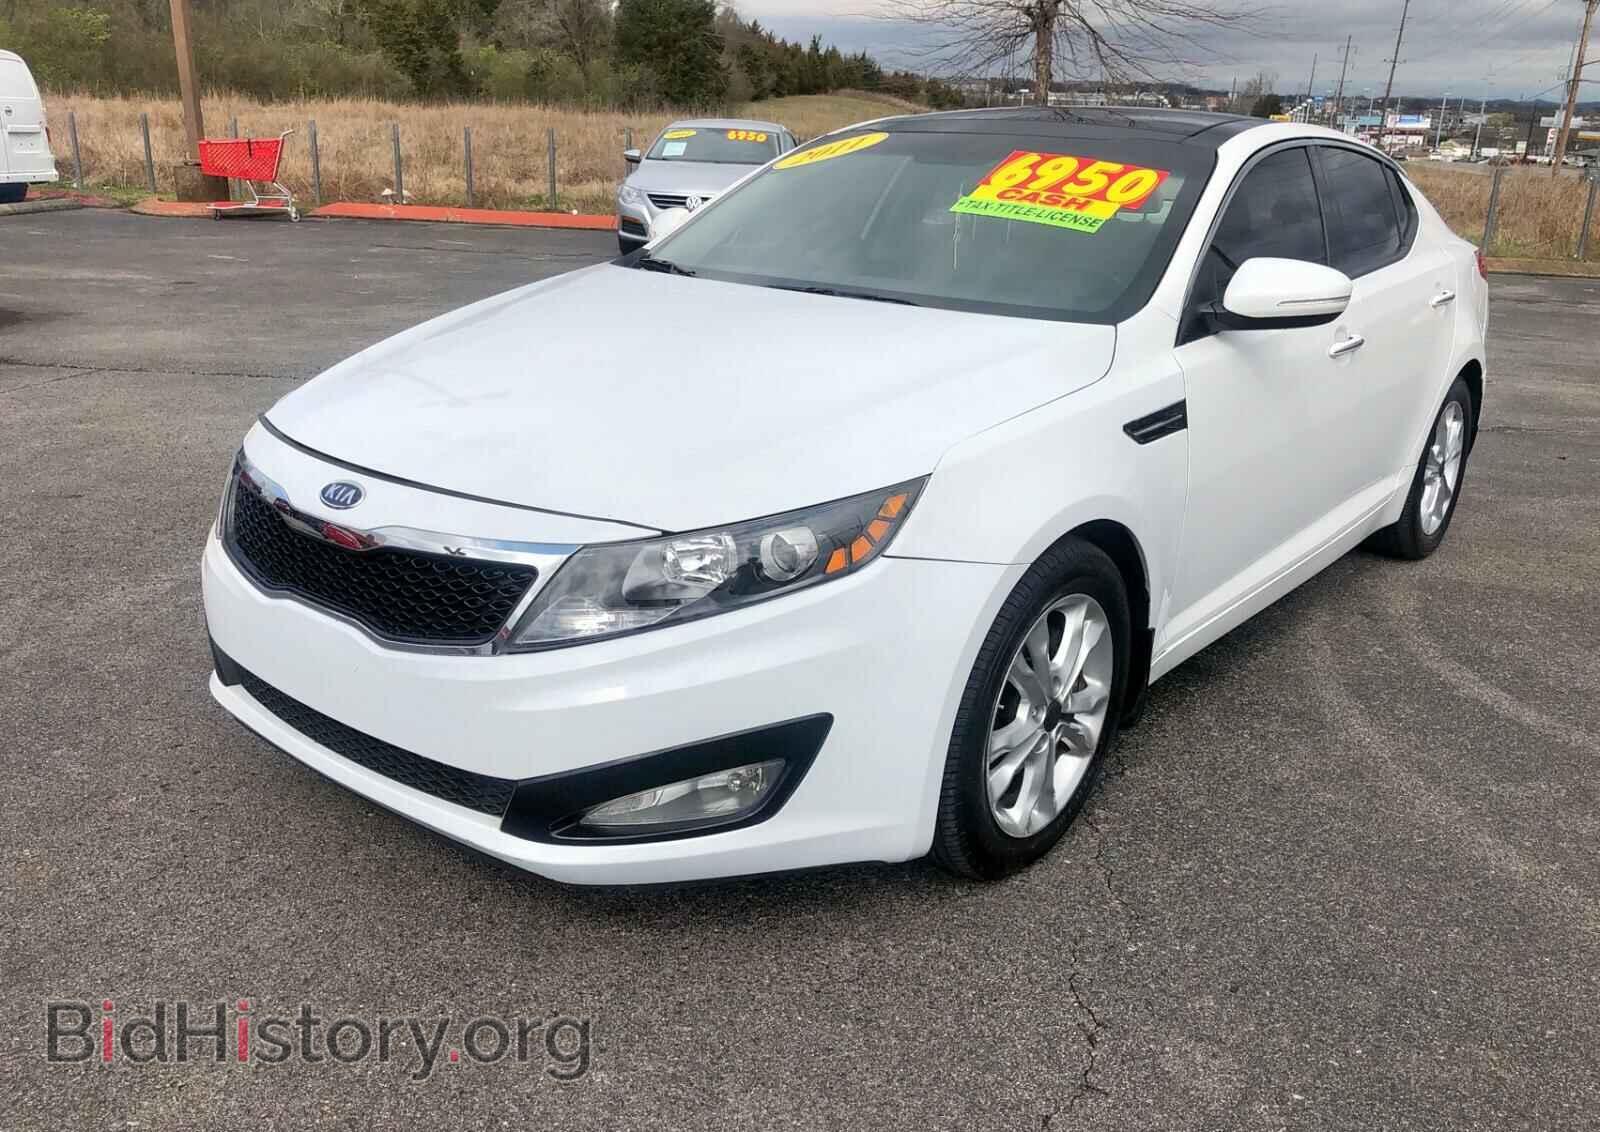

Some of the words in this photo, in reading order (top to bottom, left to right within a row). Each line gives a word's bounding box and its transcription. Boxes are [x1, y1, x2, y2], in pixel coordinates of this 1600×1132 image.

[727, 129, 768, 142] 6950
[990, 152, 1161, 205] 6950
[996, 188, 1093, 210] CASH
[324, 484, 356, 505] KIA
